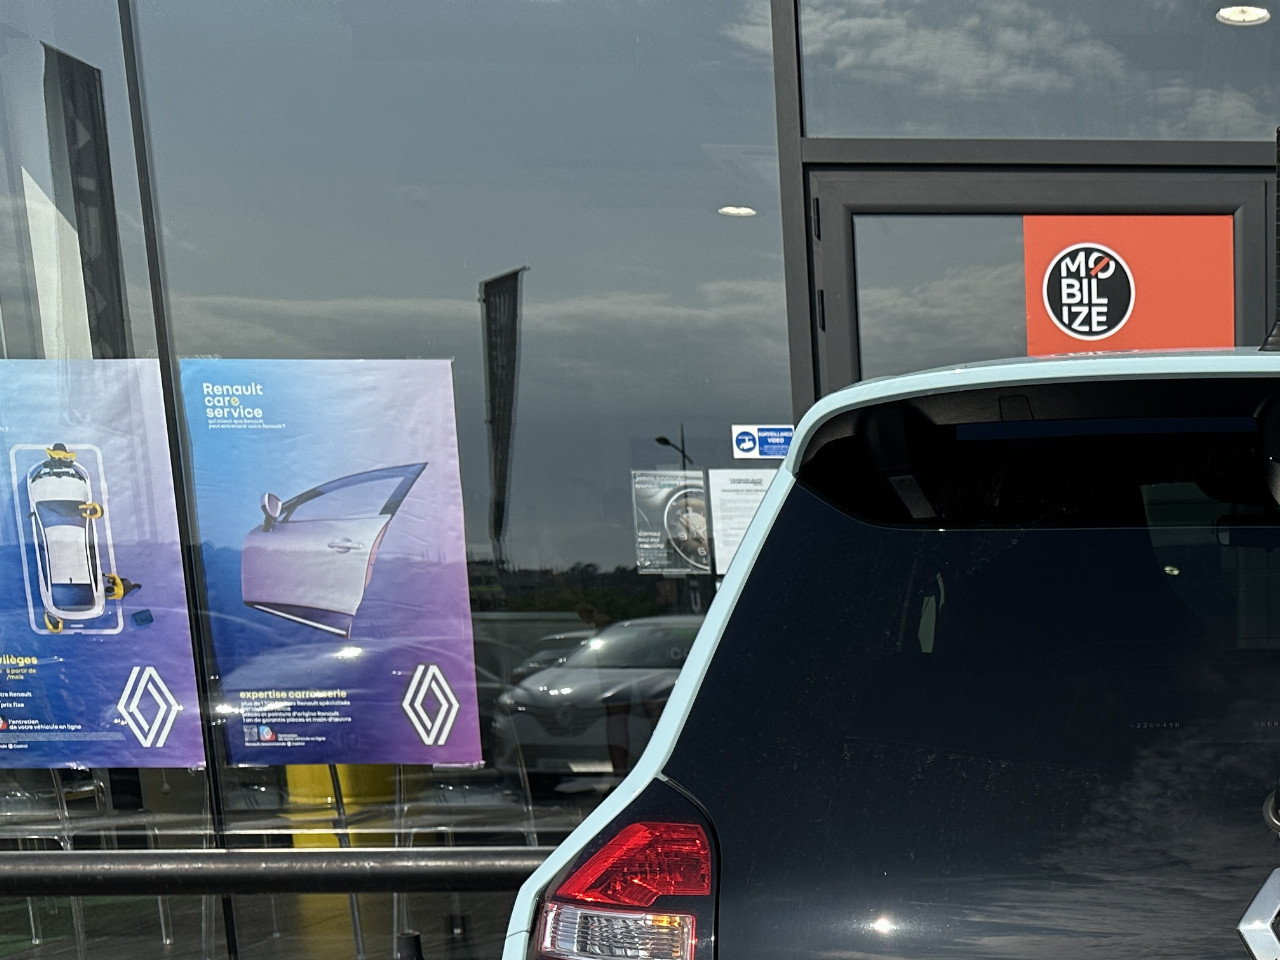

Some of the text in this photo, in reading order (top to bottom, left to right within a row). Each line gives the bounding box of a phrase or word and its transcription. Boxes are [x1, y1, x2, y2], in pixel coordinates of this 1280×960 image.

[203, 382, 263, 395] Renault
[205, 396, 240, 406] care
[206, 405, 262, 418] service
[240, 690, 287, 699] expertise
